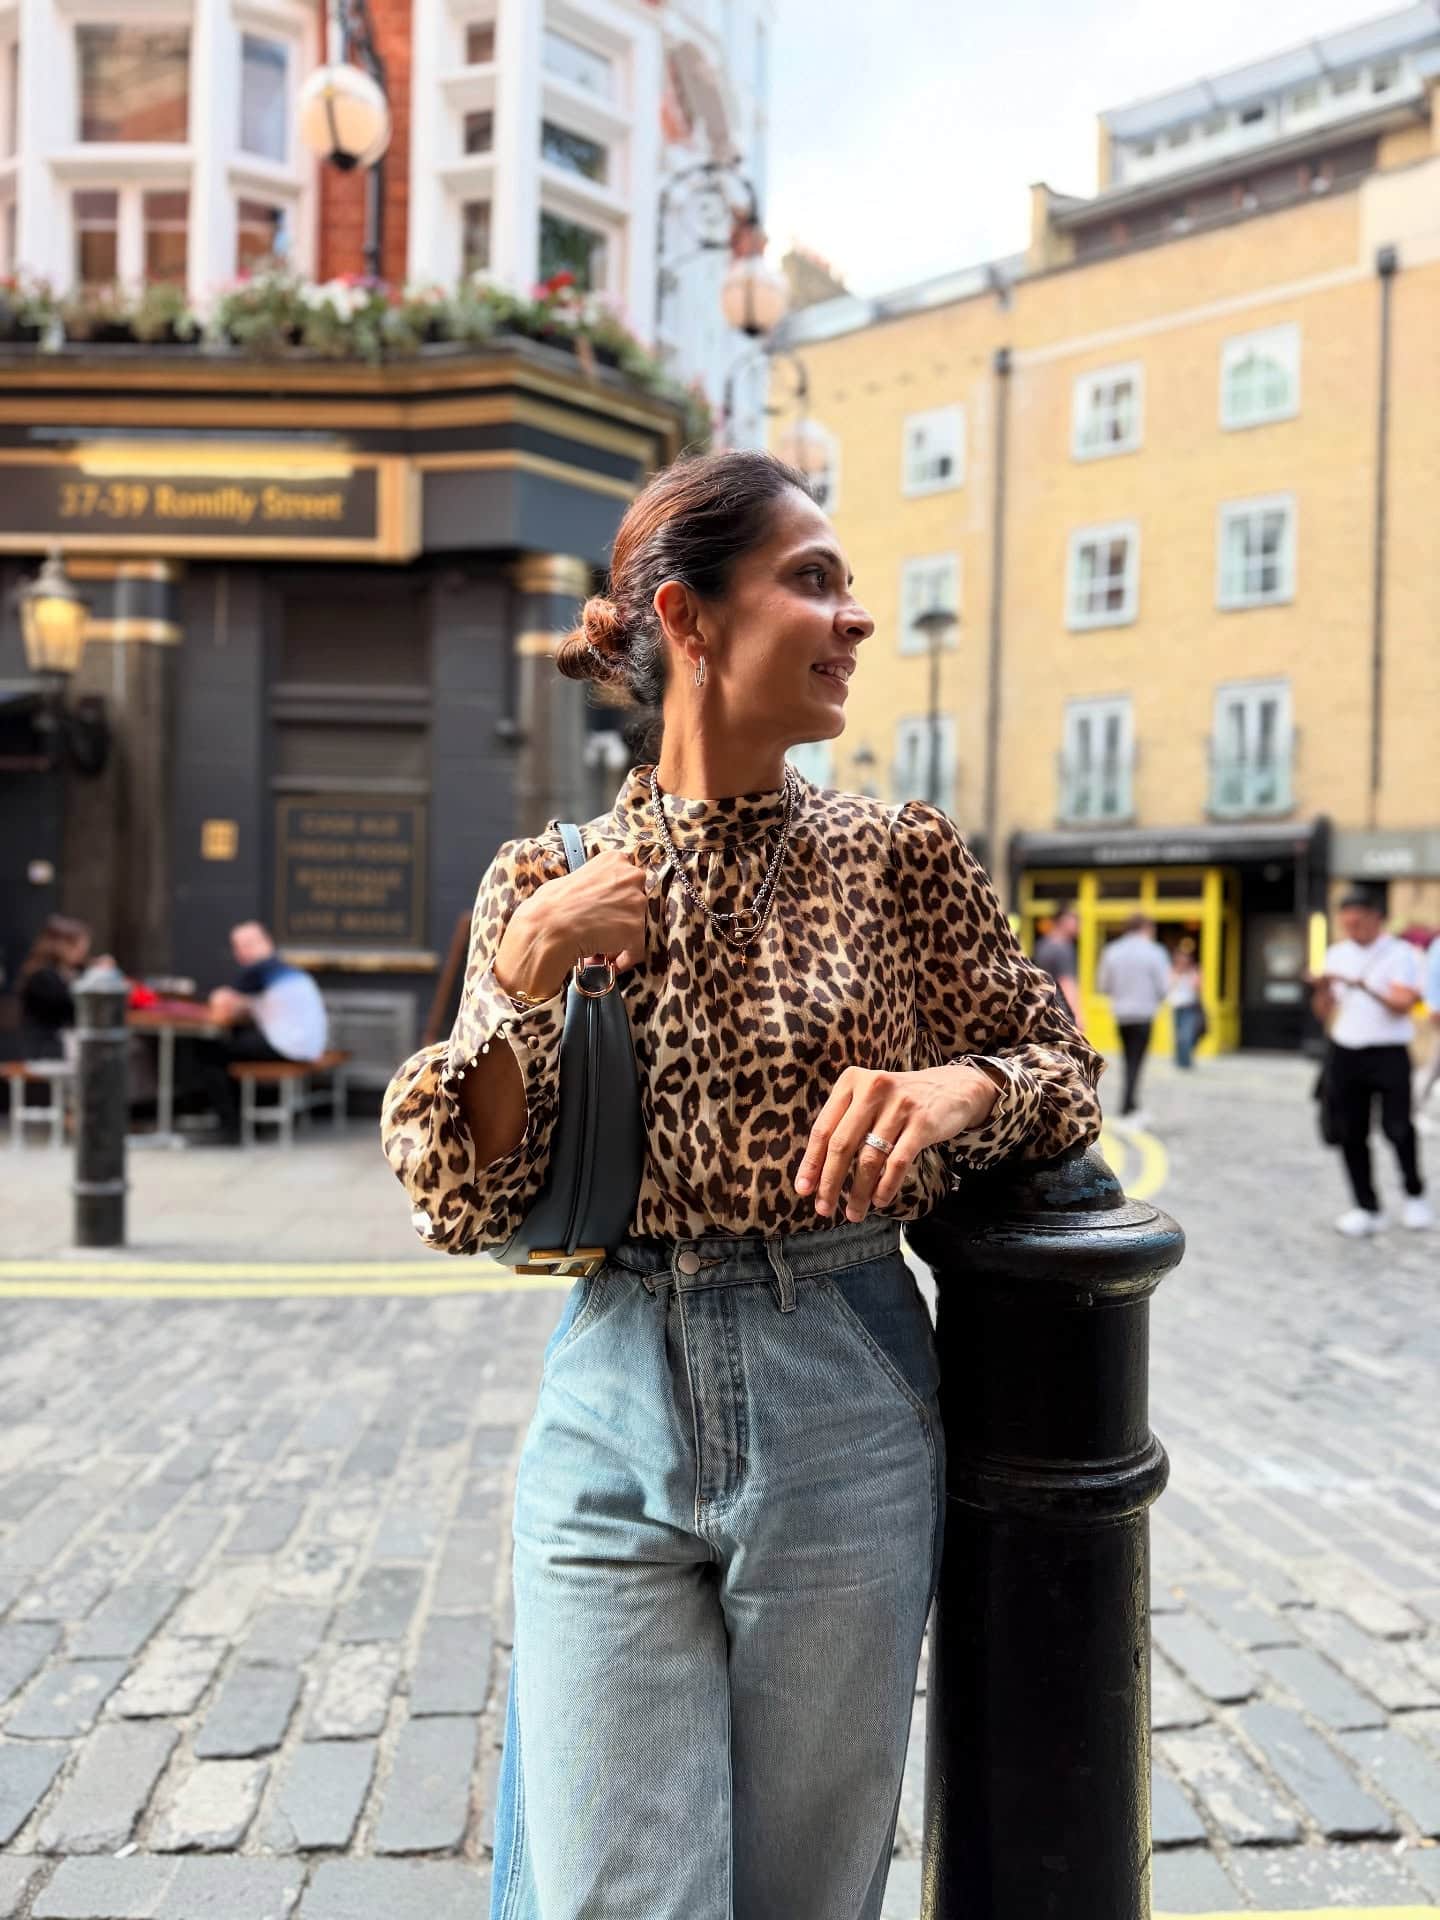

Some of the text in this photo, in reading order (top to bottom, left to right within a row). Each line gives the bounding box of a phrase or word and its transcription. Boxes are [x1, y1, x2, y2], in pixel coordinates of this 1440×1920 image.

[60, 485, 343, 523] 37-39 Romilly Street
